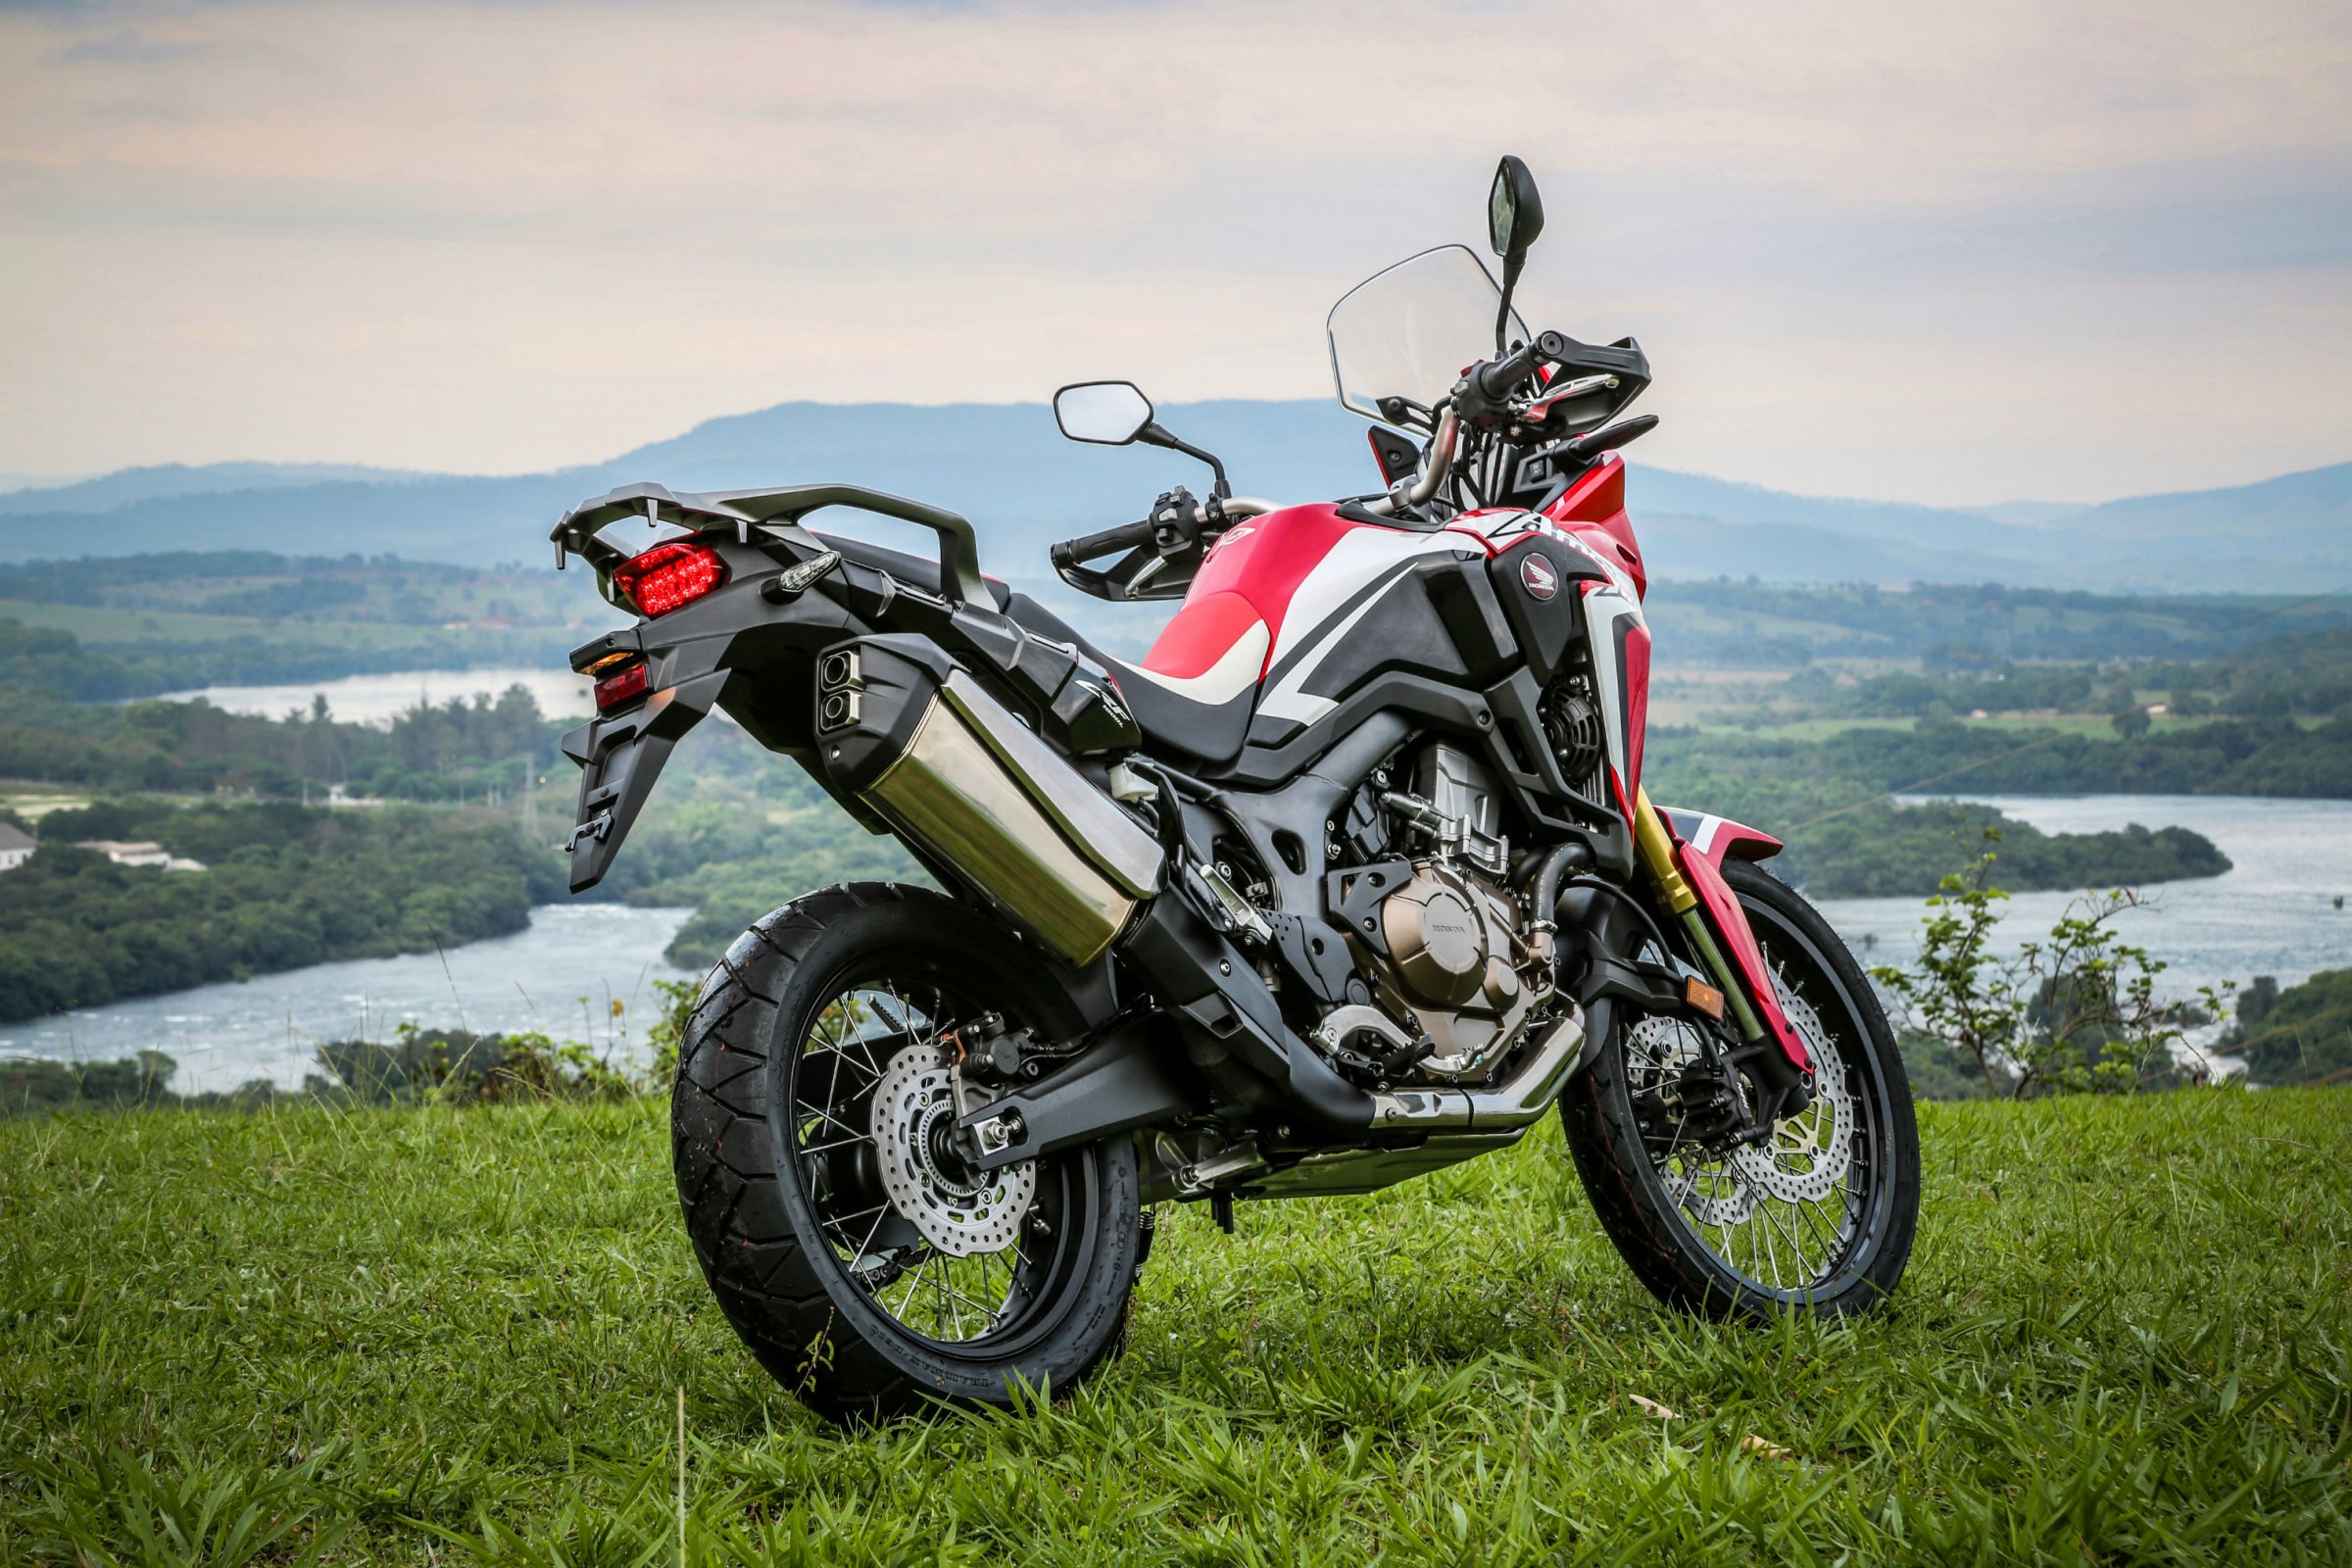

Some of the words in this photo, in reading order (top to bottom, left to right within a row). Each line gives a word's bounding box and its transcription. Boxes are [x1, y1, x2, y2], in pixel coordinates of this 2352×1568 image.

[1529, 582, 1555, 592] HONDA
[1074, 679, 1131, 721] CRF
[1102, 704, 1124, 728] 1000L
[1432, 924, 1466, 934] HONDA
